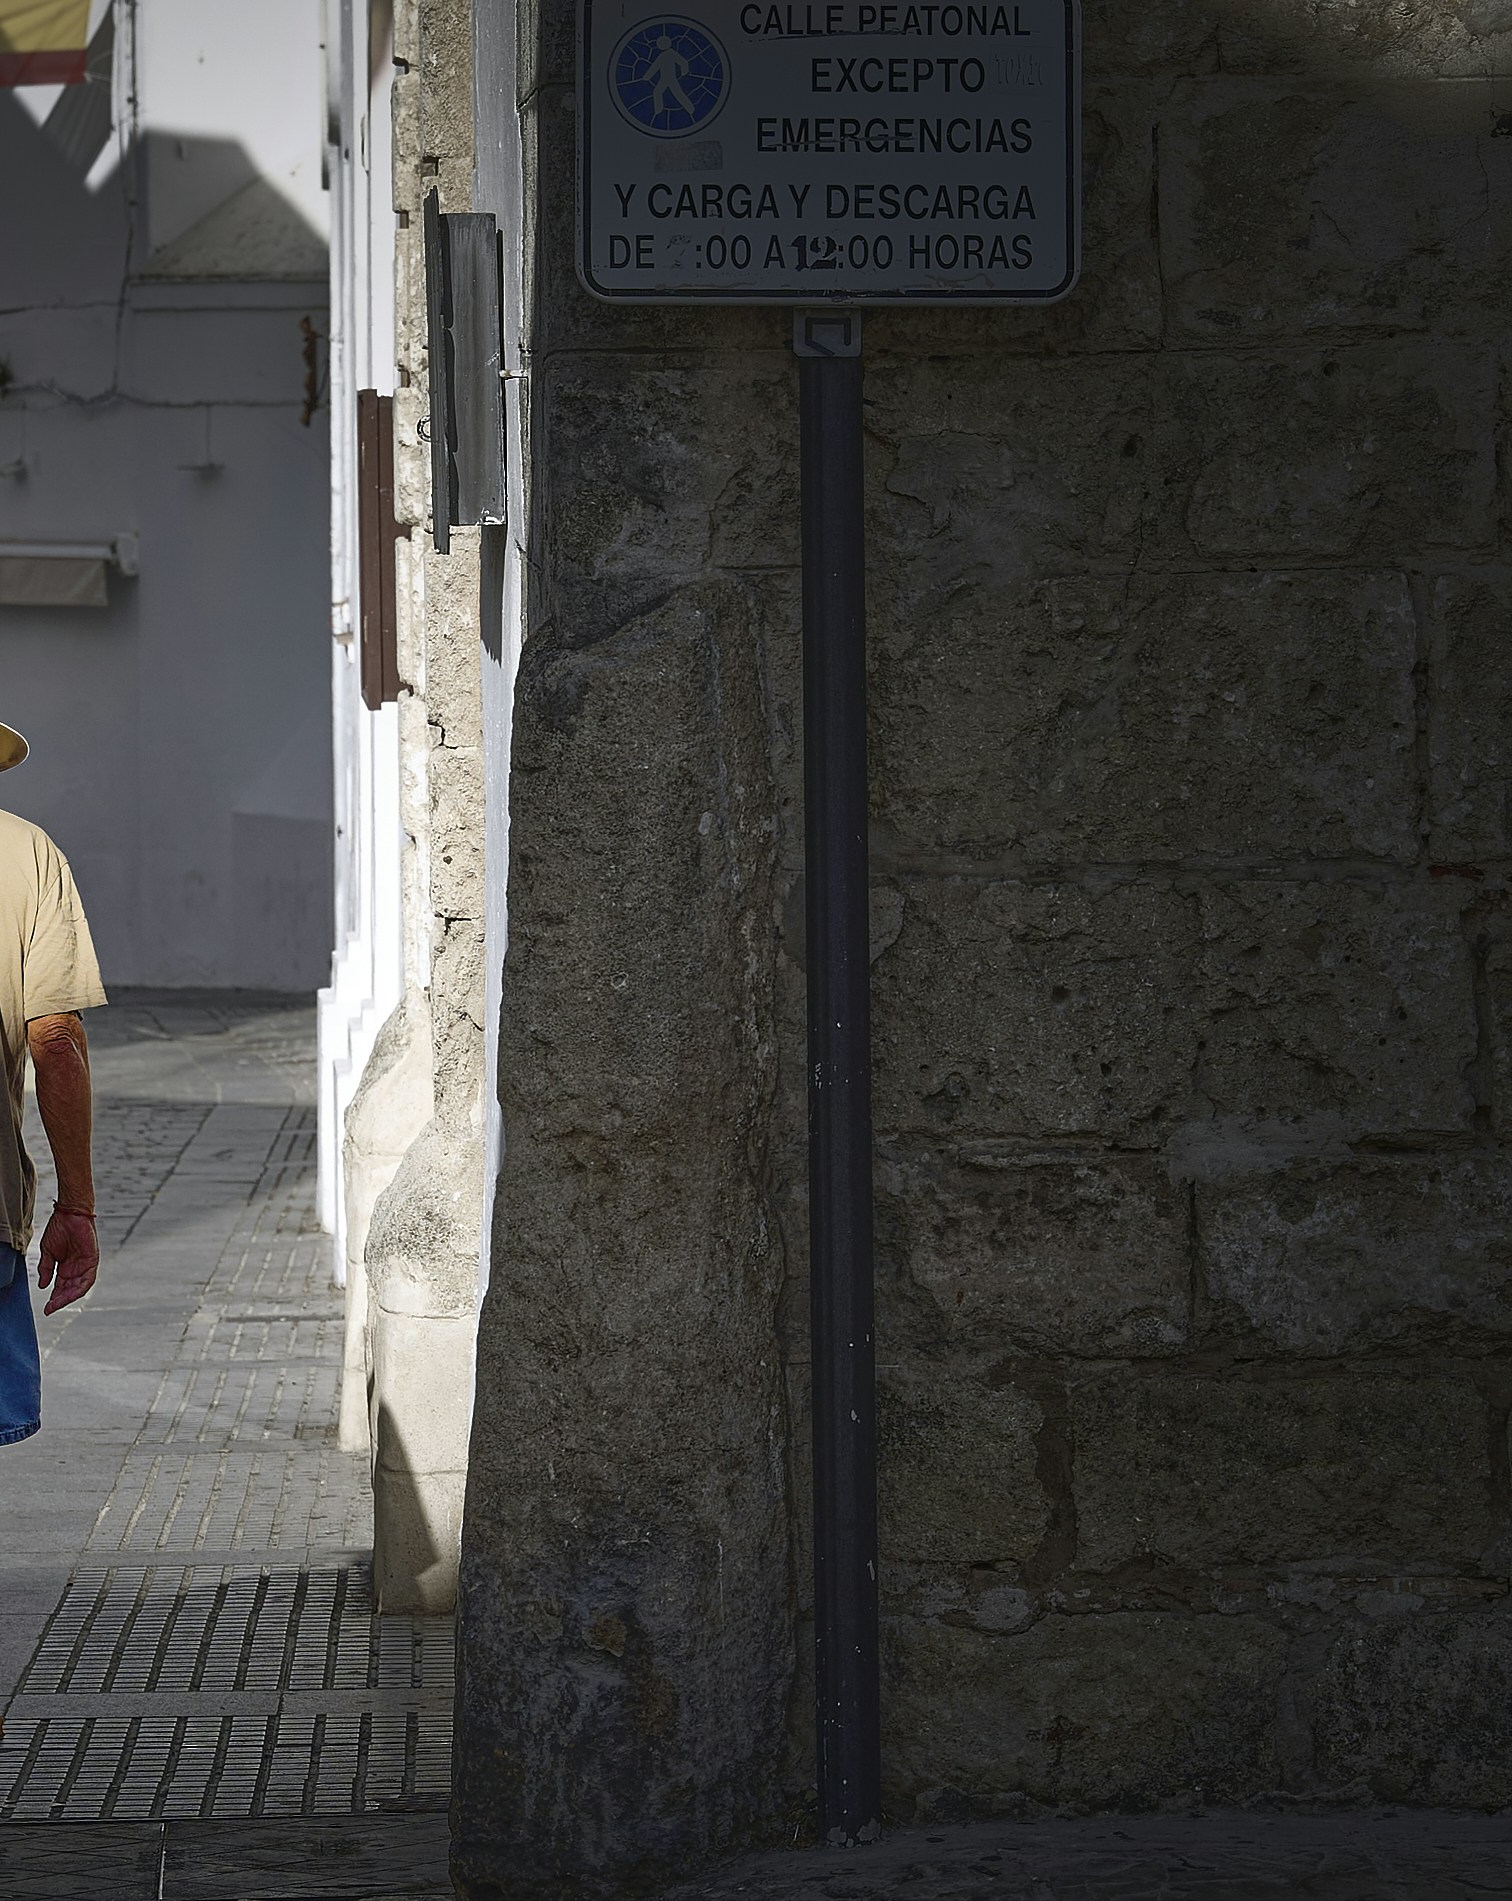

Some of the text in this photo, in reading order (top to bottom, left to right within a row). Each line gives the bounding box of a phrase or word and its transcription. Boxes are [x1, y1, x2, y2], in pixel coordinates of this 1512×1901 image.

[740, 4, 1031, 36] CALLE PEATONAL
[811, 58, 985, 93] EXCEPTO
[757, 118, 1032, 153] EMERGENCIAS
[615, 184, 1036, 219] Y CARGA Y DESCARGA
[609, 235, 1033, 271] DE :00 A 12:00 HORAS
